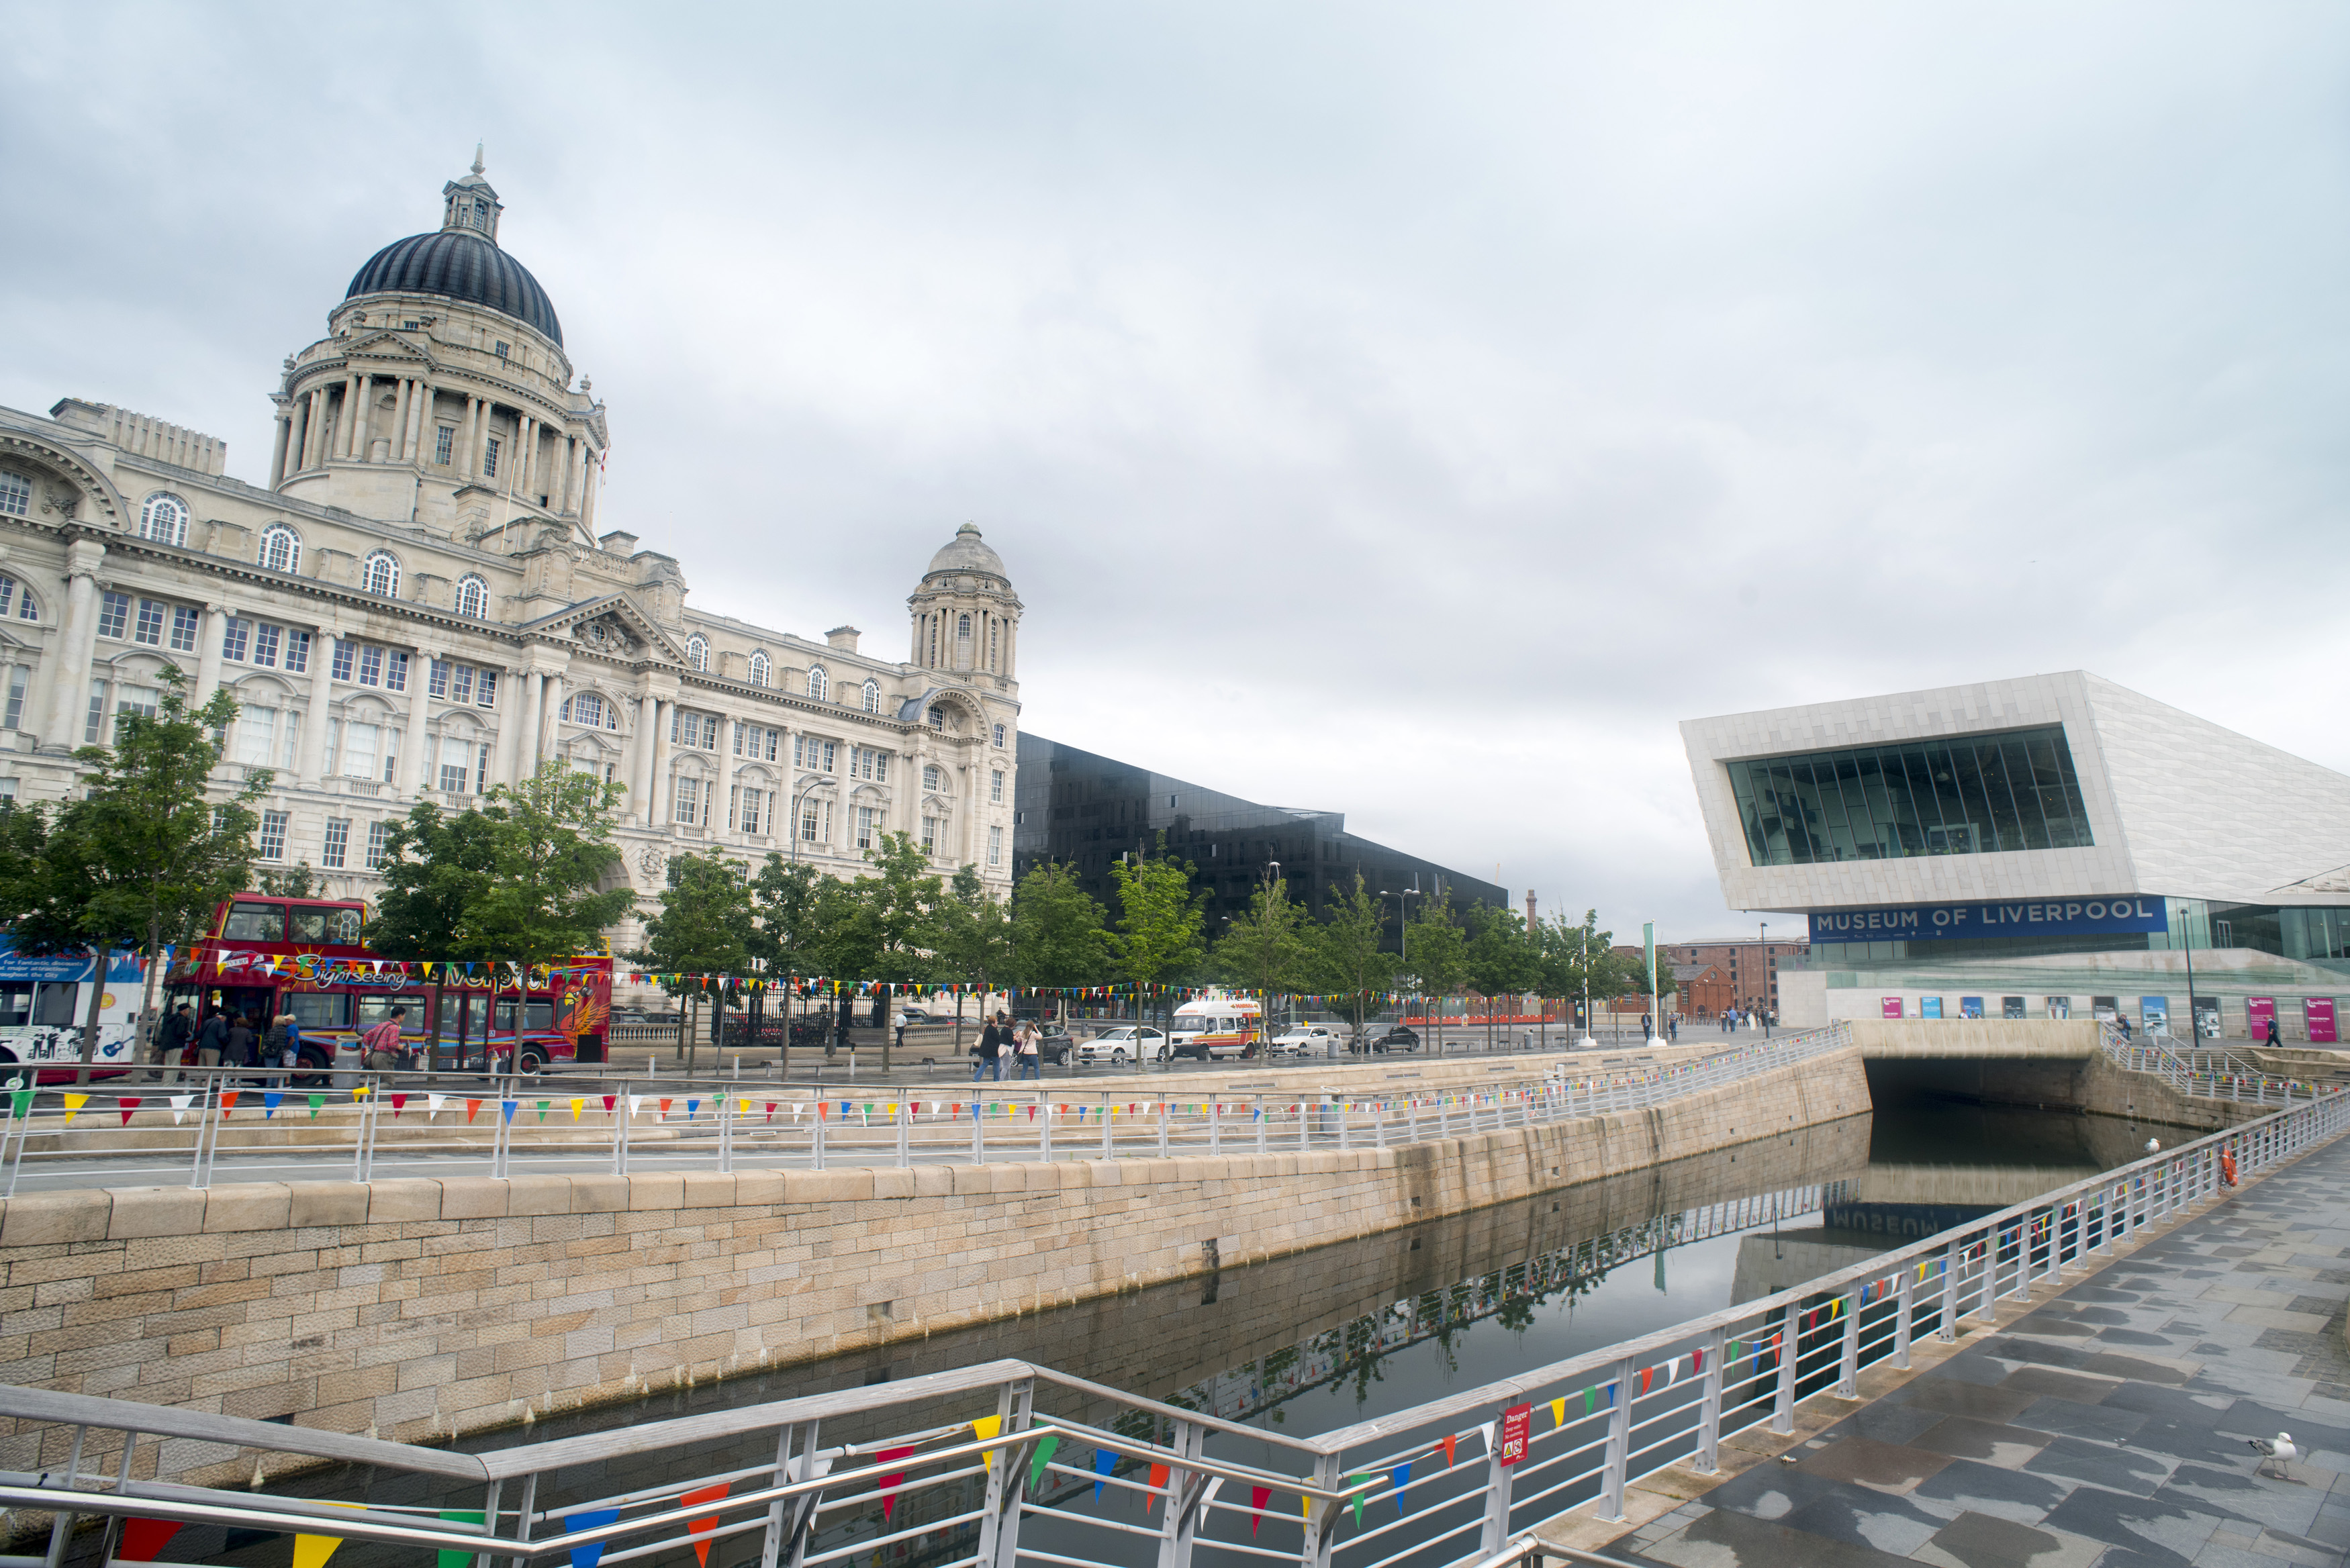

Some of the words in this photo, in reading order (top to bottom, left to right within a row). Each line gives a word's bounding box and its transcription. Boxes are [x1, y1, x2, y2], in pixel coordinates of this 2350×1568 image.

[1817, 911, 1918, 931] MUSEUM
[1932, 908, 1967, 926] OF
[1982, 900, 2153, 924] LIVERPOOL
[1506, 1411, 1528, 1424] Danger
